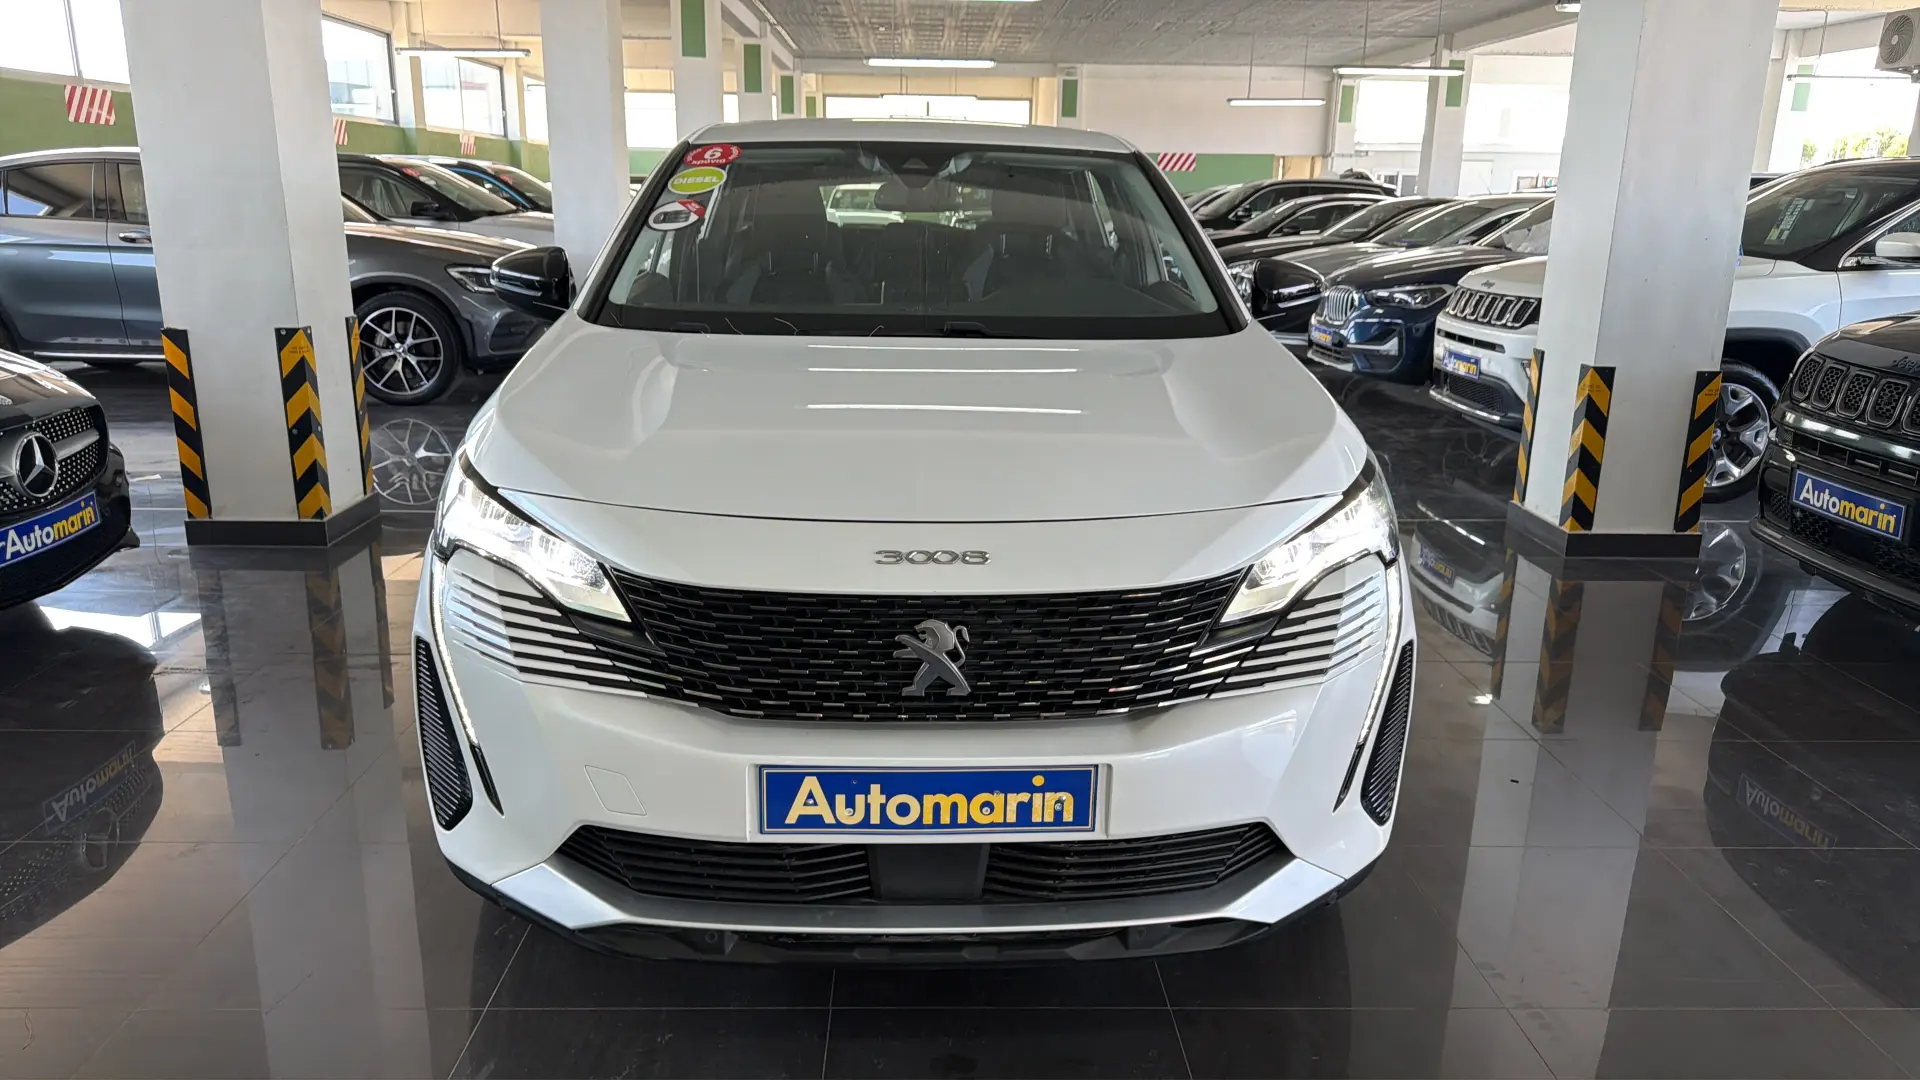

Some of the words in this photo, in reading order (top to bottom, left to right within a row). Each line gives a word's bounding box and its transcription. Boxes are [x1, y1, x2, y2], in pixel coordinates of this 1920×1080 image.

[704, 147, 724, 160] 6
[673, 175, 720, 185] DIESEL
[1799, 478, 1897, 533] Automarin
[6, 501, 96, 560] Automarin
[874, 549, 991, 565] 3008
[785, 775, 1075, 825] Automarin
